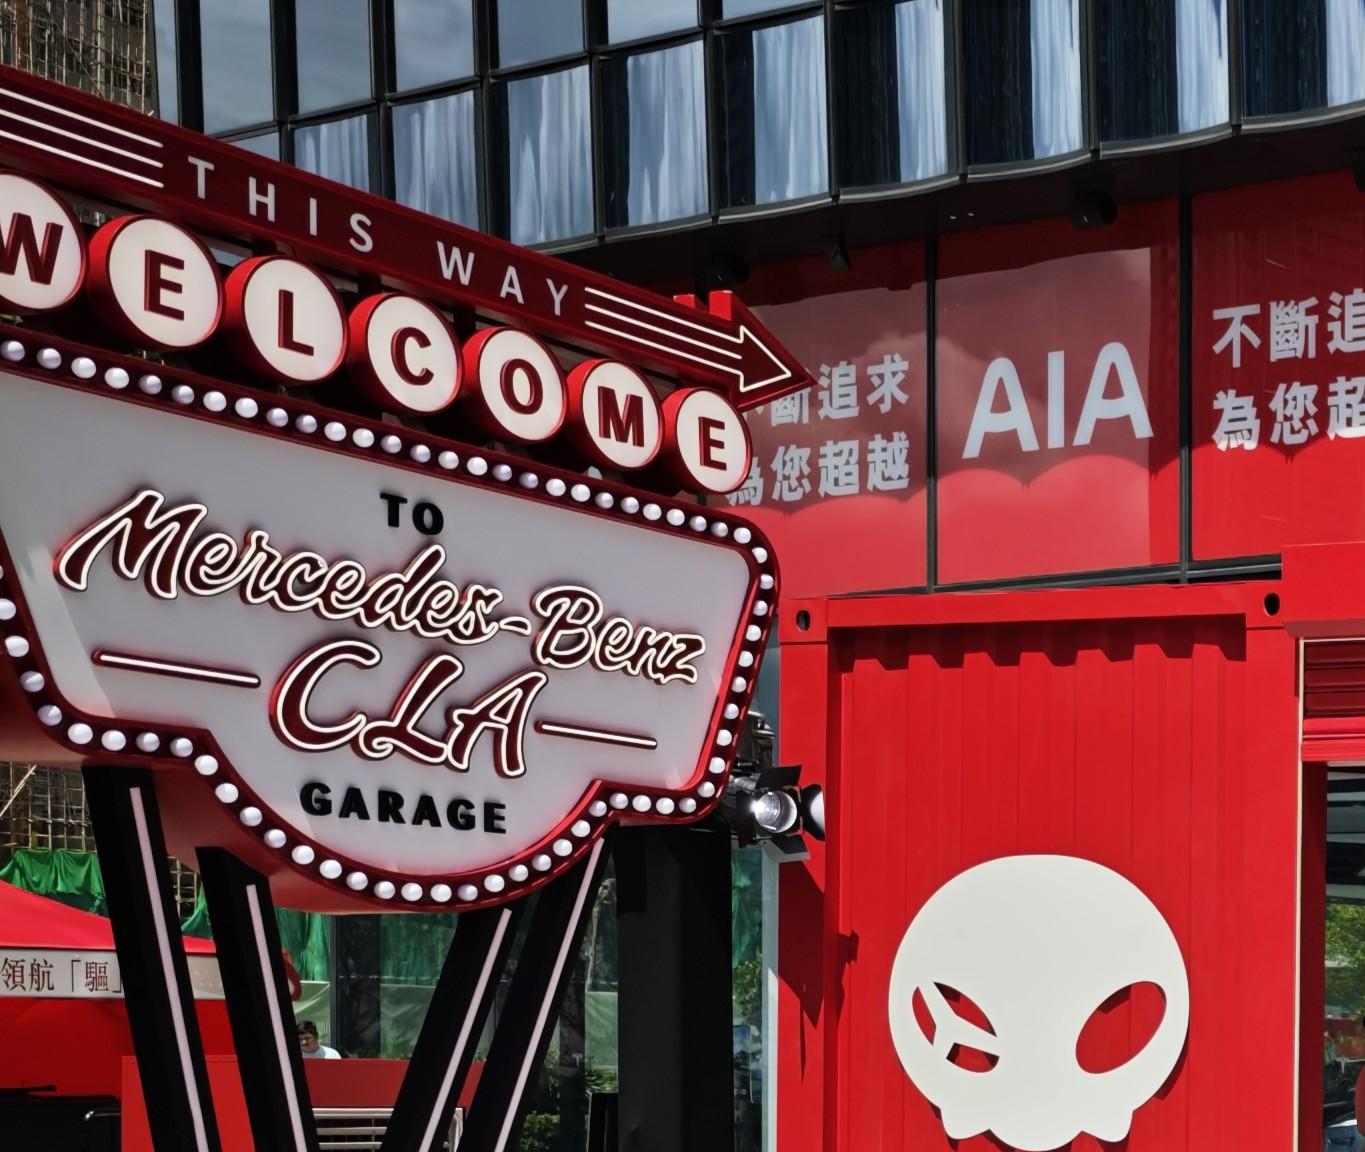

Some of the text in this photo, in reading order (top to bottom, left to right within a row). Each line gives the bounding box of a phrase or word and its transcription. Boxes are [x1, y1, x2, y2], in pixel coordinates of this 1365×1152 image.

[188, 156, 569, 317] THIS WAY
[742, 353, 909, 427] 斷追求
[962, 342, 1154, 459] AIA
[380, 492, 445, 536] TO
[53, 488, 706, 684] Mercedes-Benz
[269, 640, 548, 778] CLA
[300, 781, 507, 834] GARAGE
